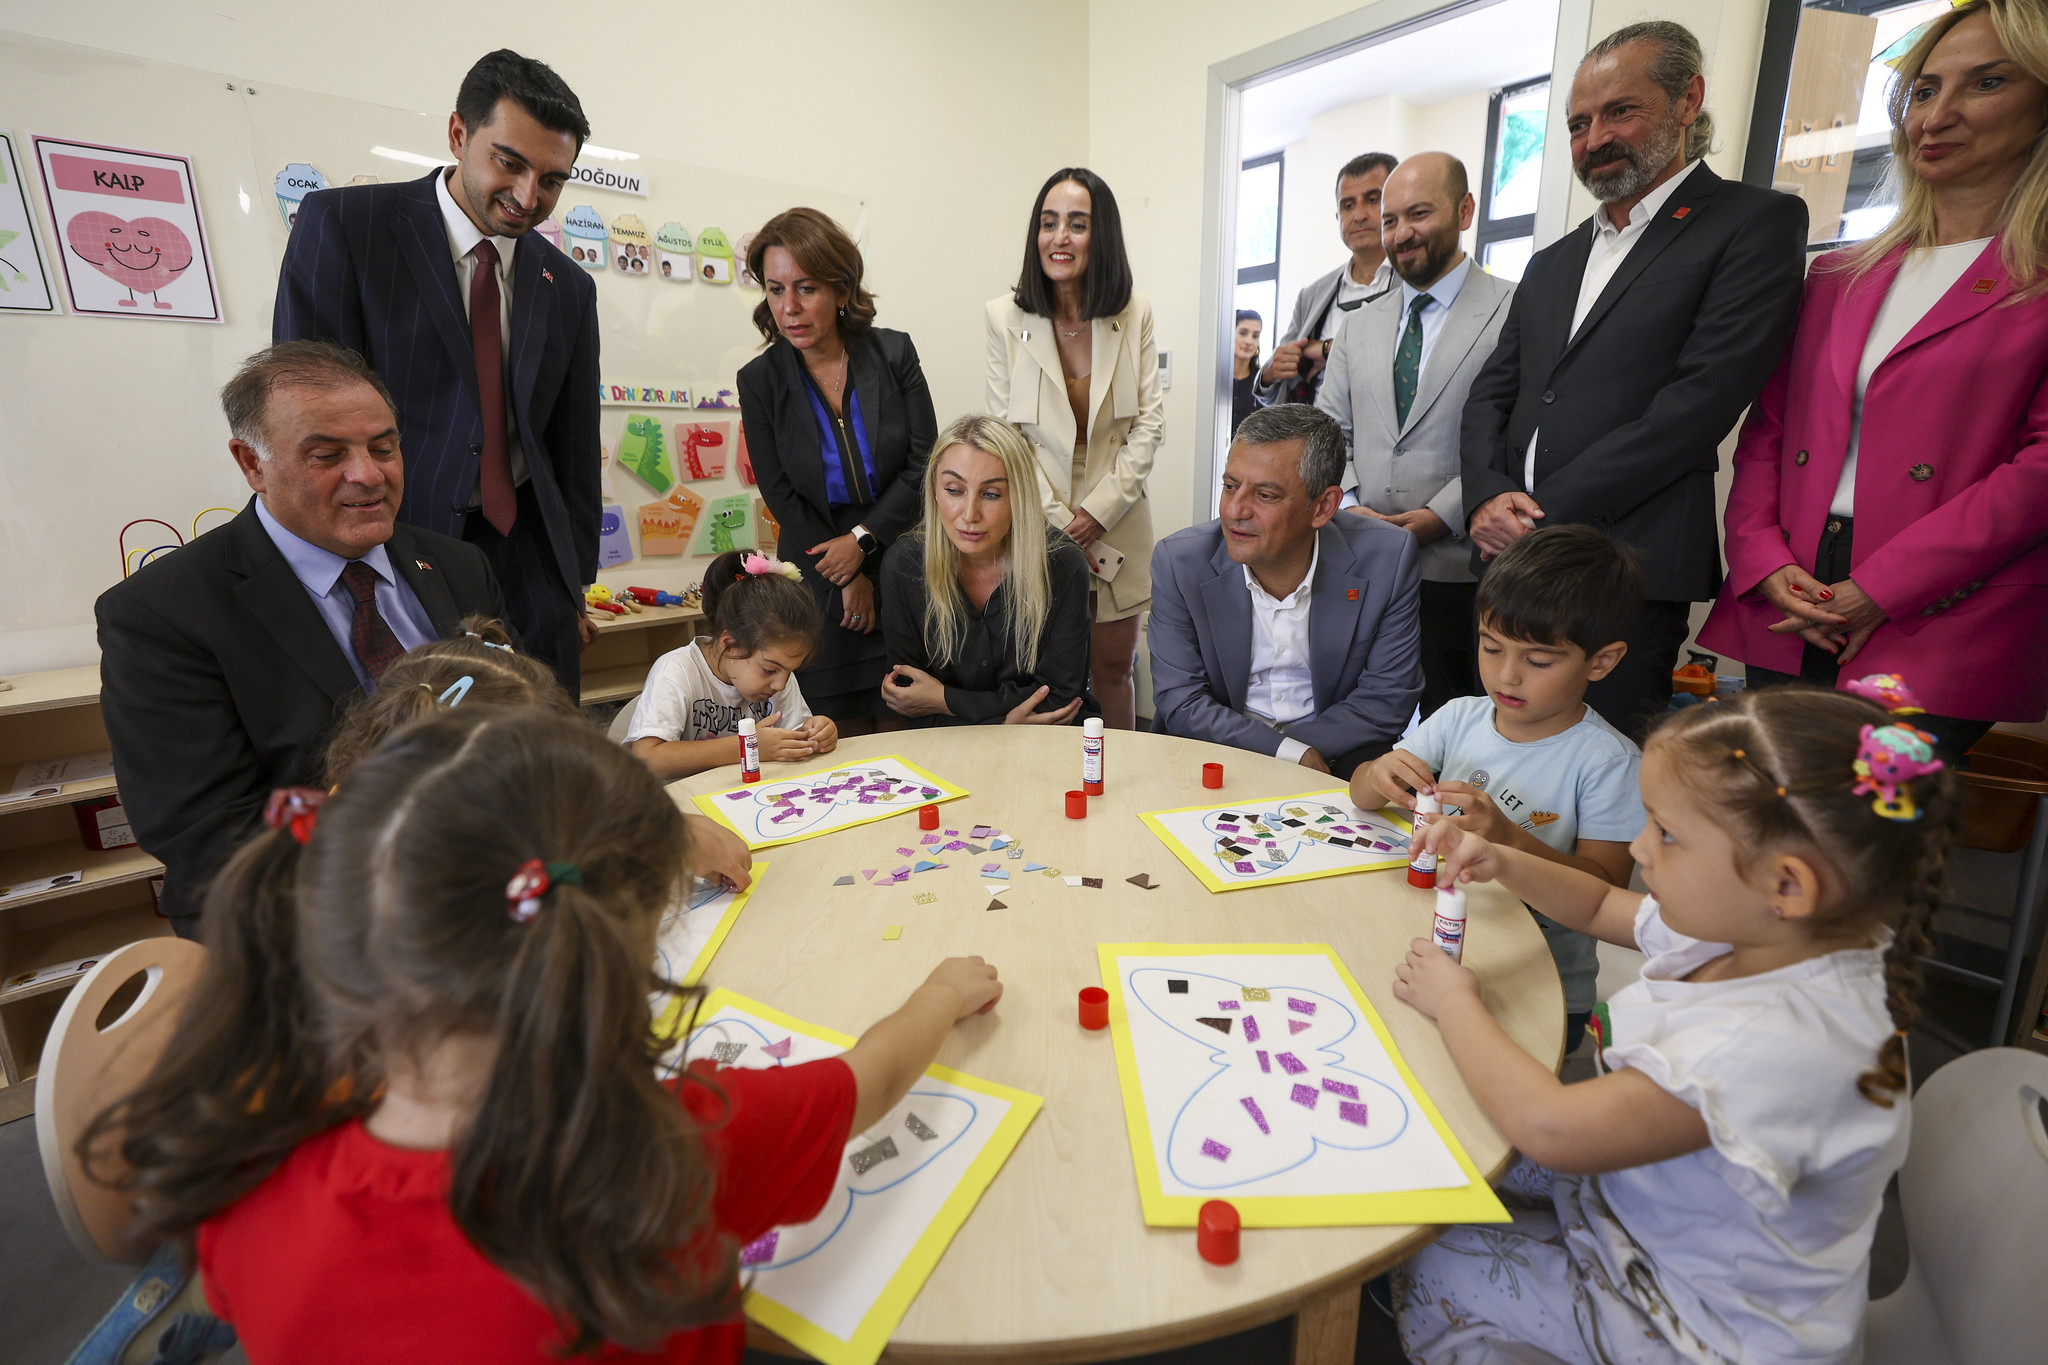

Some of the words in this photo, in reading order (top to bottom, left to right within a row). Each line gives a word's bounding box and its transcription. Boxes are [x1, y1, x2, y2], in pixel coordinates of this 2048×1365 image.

[93, 170, 145, 192] KALP
[287, 177, 319, 190] OCAK
[570, 166, 640, 192] DOĞDUN
[565, 217, 604, 230] HAZİRAN
[612, 226, 646, 238] TEMMUZ
[657, 235, 692, 248] AĞUSTOS
[703, 237, 724, 247] EYLÜL
[1499, 788, 1524, 812] LET
